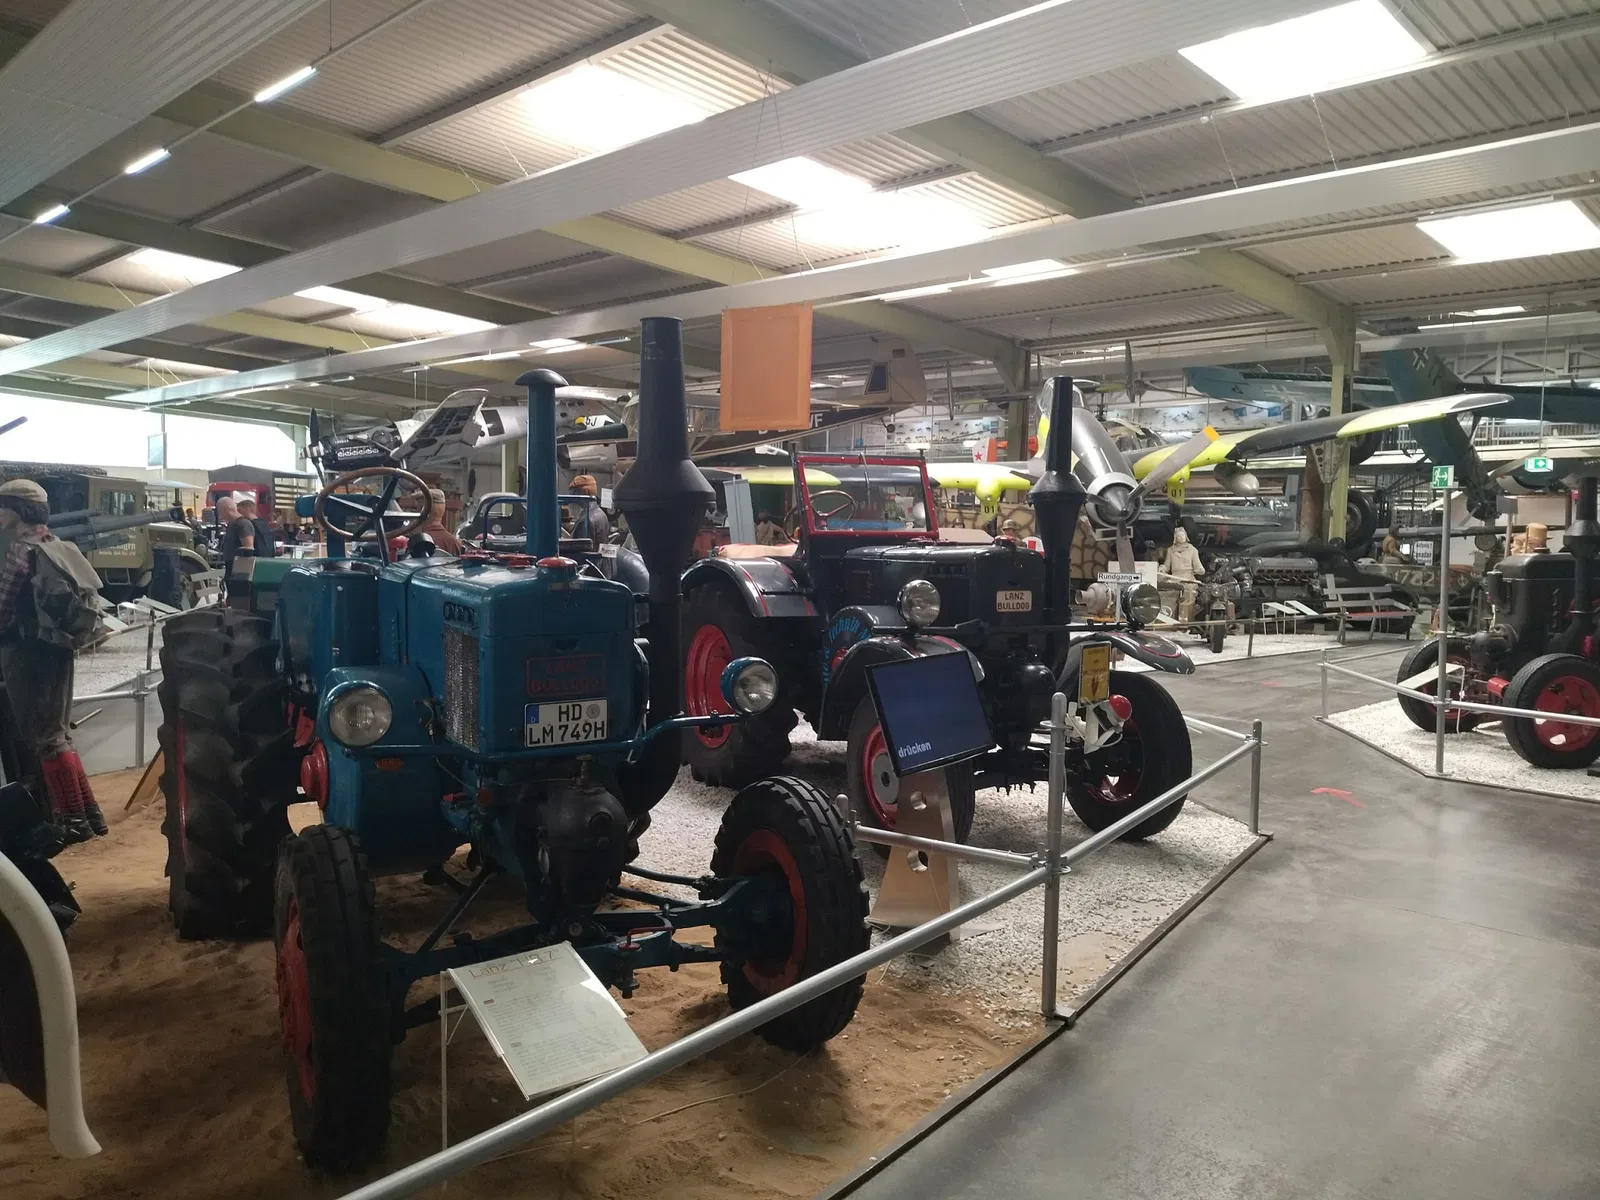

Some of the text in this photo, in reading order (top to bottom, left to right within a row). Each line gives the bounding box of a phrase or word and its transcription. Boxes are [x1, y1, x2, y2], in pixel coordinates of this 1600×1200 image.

[984, 505, 995, 514] 01
[1098, 573, 1133, 582] Rundgang
[1004, 592, 1024, 601] LANZ
[997, 602, 1030, 611] BULLDOG
[558, 704, 582, 722] HD
[529, 721, 605, 744] LM 749H
[898, 741, 932, 758] drücken
[469, 964, 506, 978] Lanz
